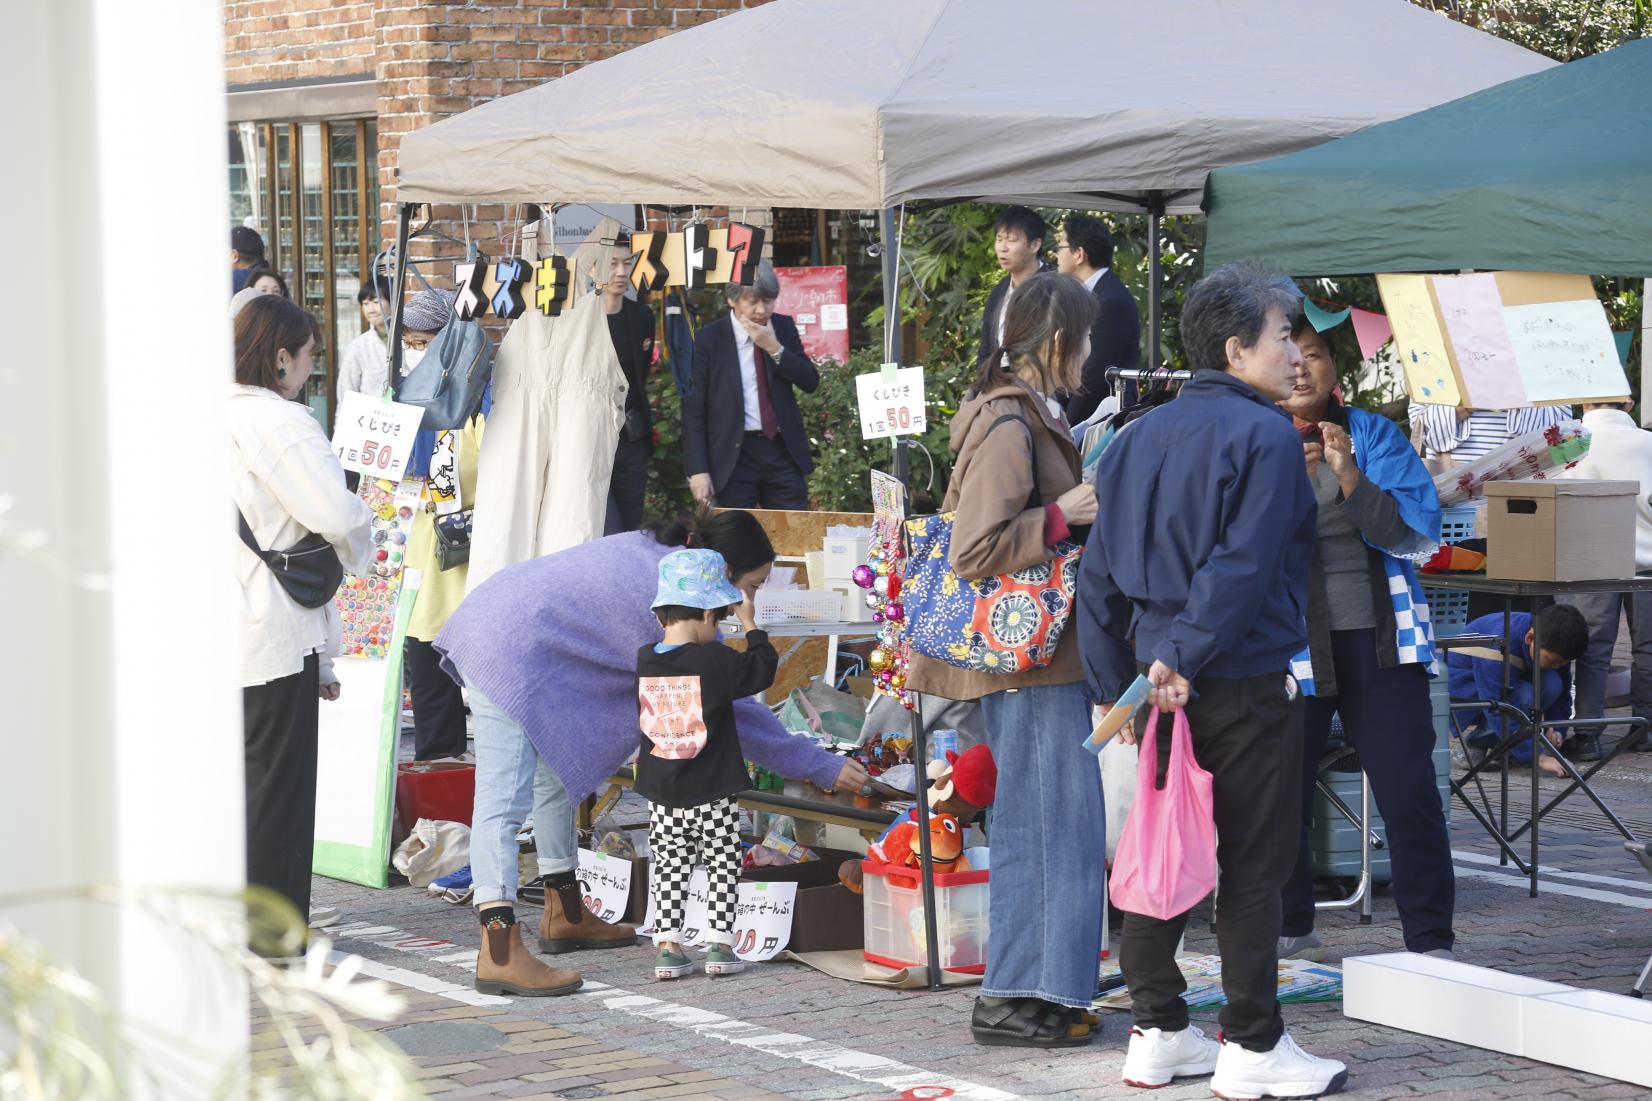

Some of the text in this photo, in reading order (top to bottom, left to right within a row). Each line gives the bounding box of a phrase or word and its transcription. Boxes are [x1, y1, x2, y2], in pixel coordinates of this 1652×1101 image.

[452, 222, 765, 321] スズキ ストア
[873, 385, 910, 400] くじびき
[358, 415, 401, 437] くじびき
[868, 406, 922, 433] 1回50円
[338, 440, 400, 472] 1回50円
[648, 731, 696, 739] CONFIDENCE
[601, 873, 627, 891] ぜーんぶ
[759, 900, 791, 915] ぜーんぶ
